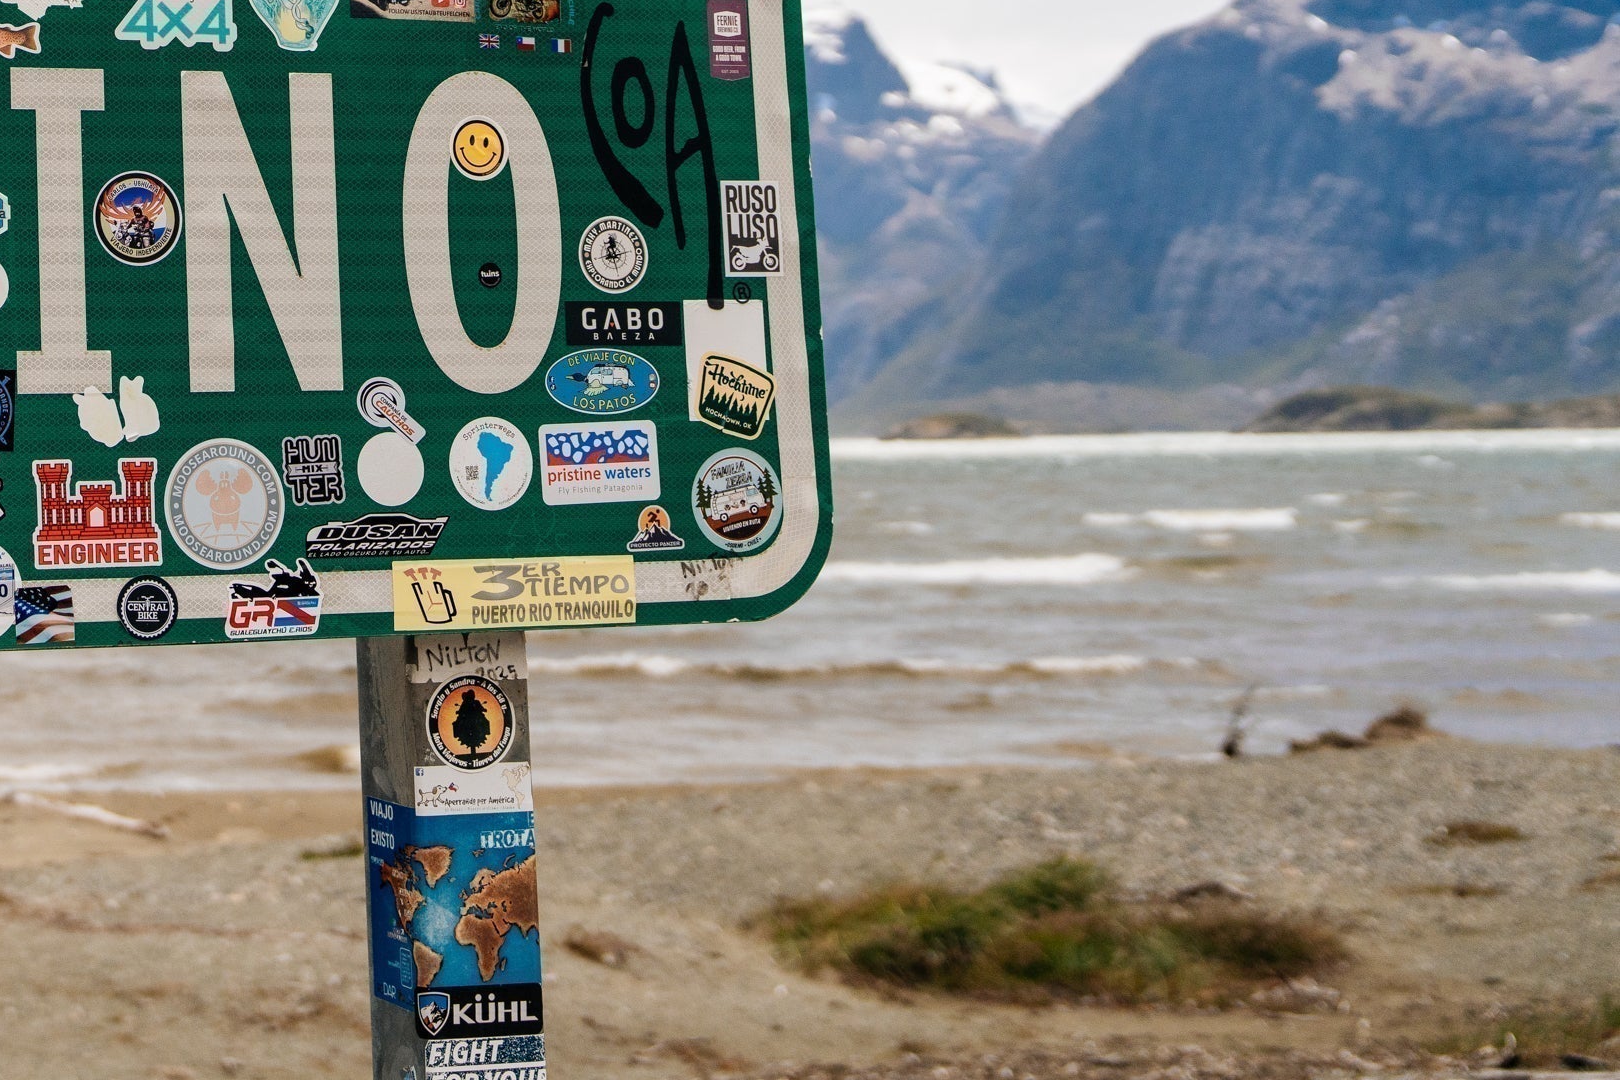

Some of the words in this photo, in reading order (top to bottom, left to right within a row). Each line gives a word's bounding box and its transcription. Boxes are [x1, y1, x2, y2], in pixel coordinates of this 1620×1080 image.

[717, 15, 738, 26] FERNIE
[725, 185, 776, 214] RUSO
[581, 307, 664, 330] GABO
[593, 332, 656, 341] BAEZA
[568, 355, 584, 367] DE
[585, 352, 610, 364] VIAJE
[612, 352, 635, 366] CON
[573, 395, 596, 409] LOS
[598, 393, 636, 411] PATOS
[301, 464, 323, 473] MIX
[548, 468, 601, 486] pristine
[604, 466, 651, 480] waters
[558, 486, 572, 496] Fly
[574, 484, 601, 496] Fishing
[603, 483, 643, 495] Patagonia
[316, 523, 442, 541] DUSAN
[38, 542, 158, 566] ENGINEER
[307, 541, 436, 551] POLARIZADOS
[524, 574, 629, 598] TIEMPO
[128, 602, 168, 612] CENTRAL
[138, 611, 158, 620] BIKE
[471, 602, 526, 625] PUERTO
[529, 601, 552, 623] RIO
[555, 598, 634, 622] TRANQUILO
[432, 733, 444, 751] Moto
[444, 748, 468, 767] Viajeros
[472, 754, 493, 768] Tierra
[494, 746, 504, 760] del
[501, 727, 511, 748] Fuego
[370, 800, 394, 820] VIAJO
[371, 829, 394, 850] EXISTO
[430, 1039, 504, 1066] FIGHT
